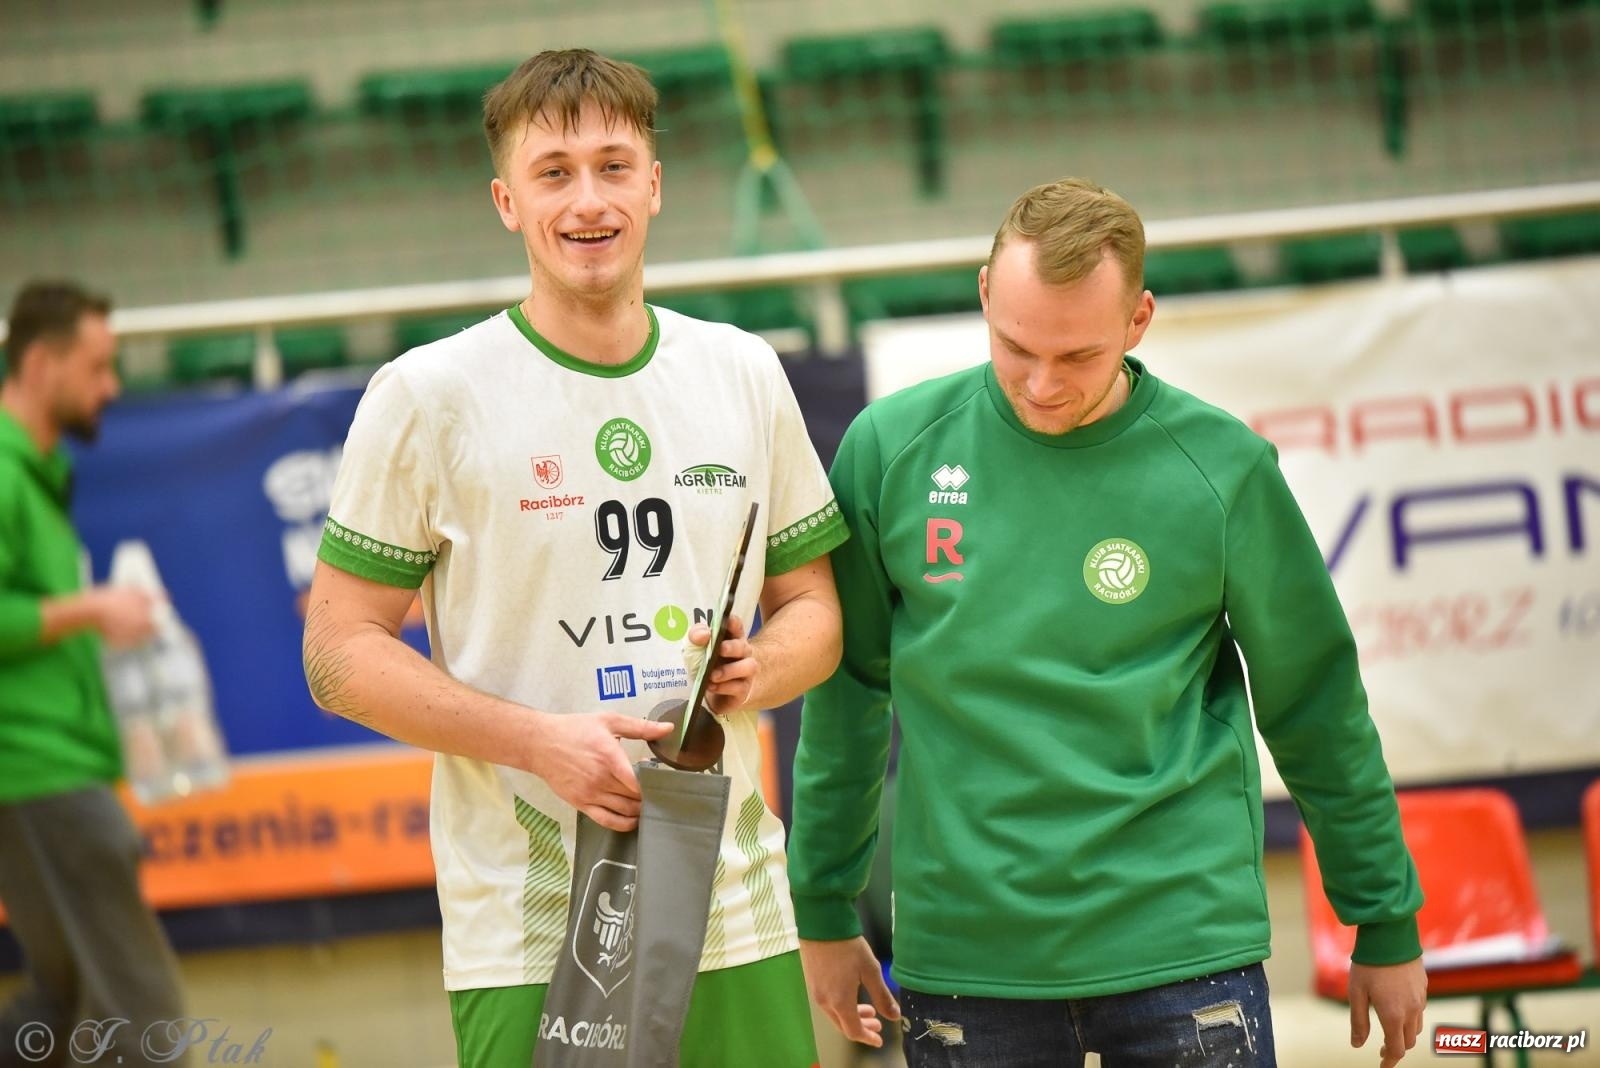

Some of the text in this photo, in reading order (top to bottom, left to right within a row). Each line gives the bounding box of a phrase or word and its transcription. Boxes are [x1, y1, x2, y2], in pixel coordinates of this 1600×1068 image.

[600, 428, 612, 450] KLUB
[519, 494, 585, 512] Racibórz
[928, 490, 968, 505] errea
[545, 511, 564, 521] 1217
[594, 497, 674, 581] 99
[926, 517, 964, 565] R
[1089, 543, 1145, 574] KLUB SIATKARSKI
[600, 666, 635, 699] bmp
[643, 679, 688, 691] porozumienia
